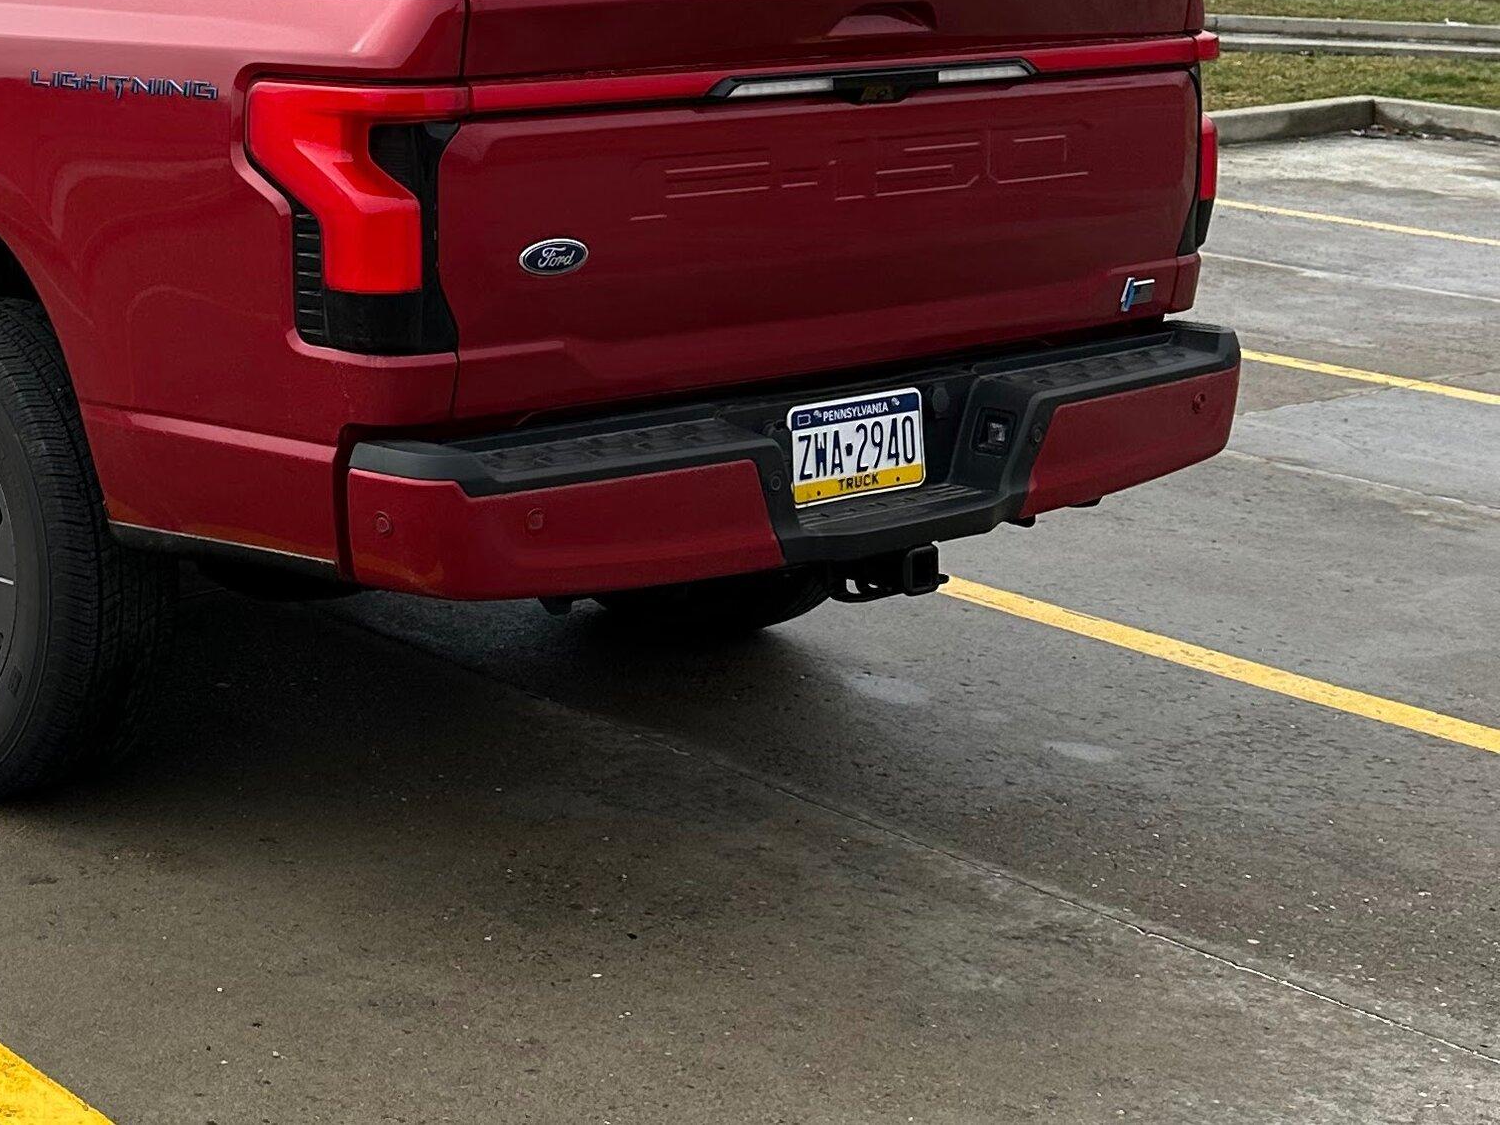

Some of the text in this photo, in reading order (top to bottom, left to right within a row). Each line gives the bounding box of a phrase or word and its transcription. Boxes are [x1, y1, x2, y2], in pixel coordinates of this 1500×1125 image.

[30, 69, 219, 101] LIGHTNING
[537, 246, 576, 269] Ford
[822, 401, 889, 422] PENNSYLVANIA
[838, 474, 880, 492] TRUCK
